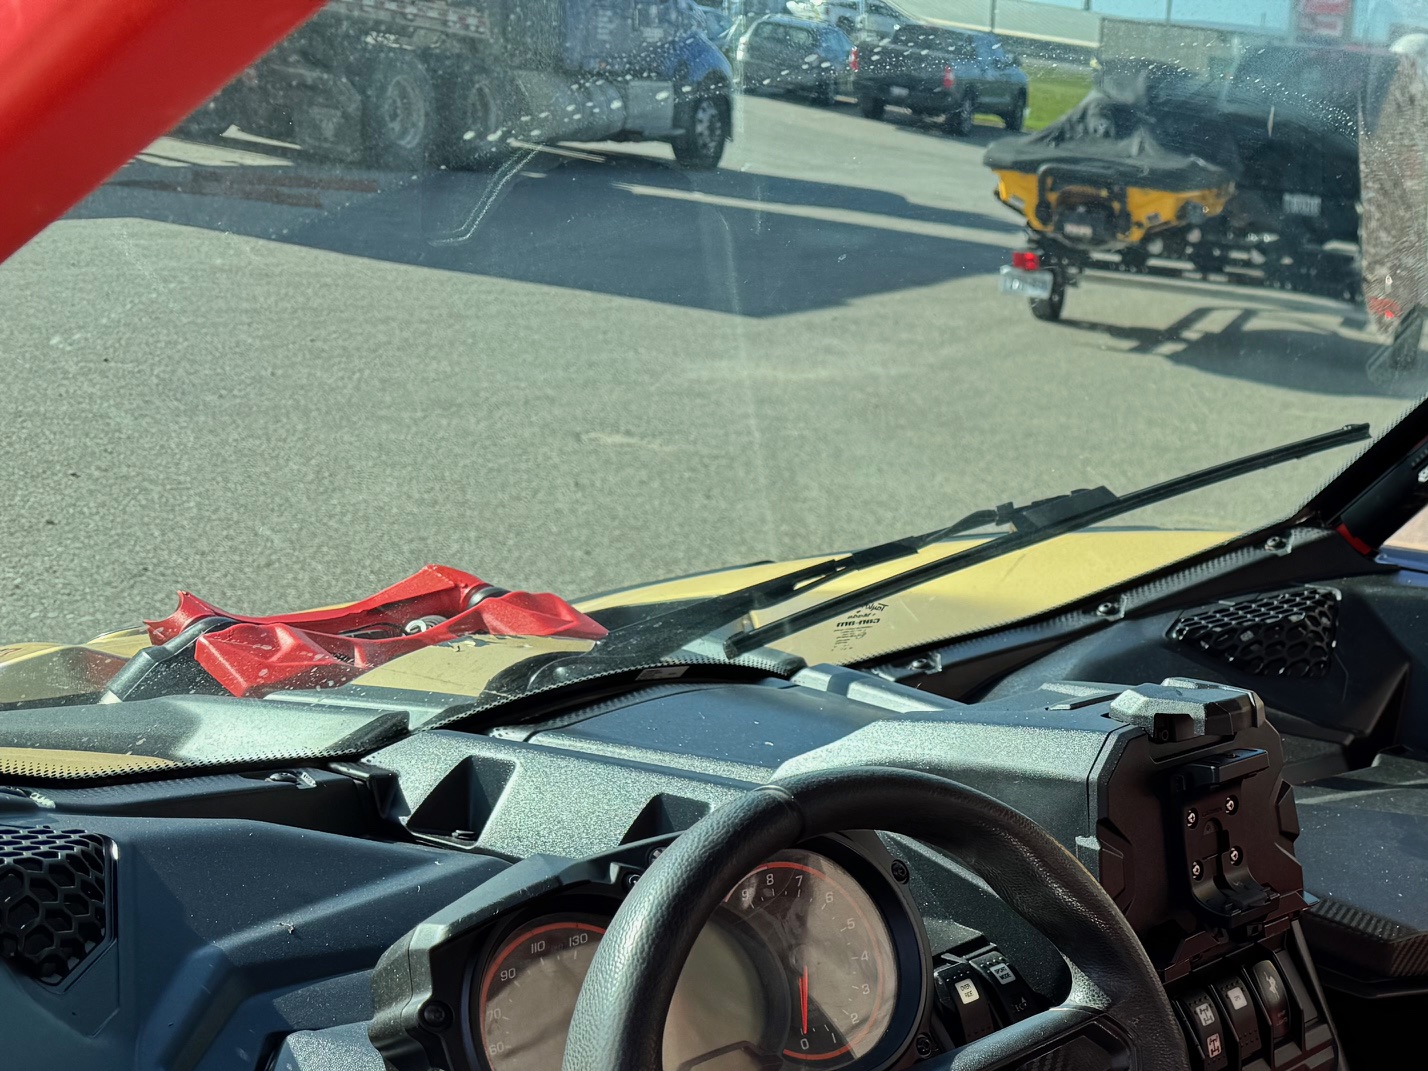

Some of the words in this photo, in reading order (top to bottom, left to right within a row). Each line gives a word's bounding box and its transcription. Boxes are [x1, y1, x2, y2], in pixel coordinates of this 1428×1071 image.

[766, 873, 774, 885] 8
[795, 875, 803, 887] 7
[741, 889, 749, 900] 9
[825, 892, 834, 903] 6
[846, 918, 855, 929] 5
[569, 933, 588, 948] 130
[531, 941, 546, 953] 110
[860, 951, 869, 961] 4
[500, 967, 516, 981] 90
[861, 984, 871, 995] 3
[487, 1008, 501, 1021] 70
[850, 1013, 859, 1024] 2
[488, 1042, 504, 1056] 60
[800, 1038, 809, 1050] 0
